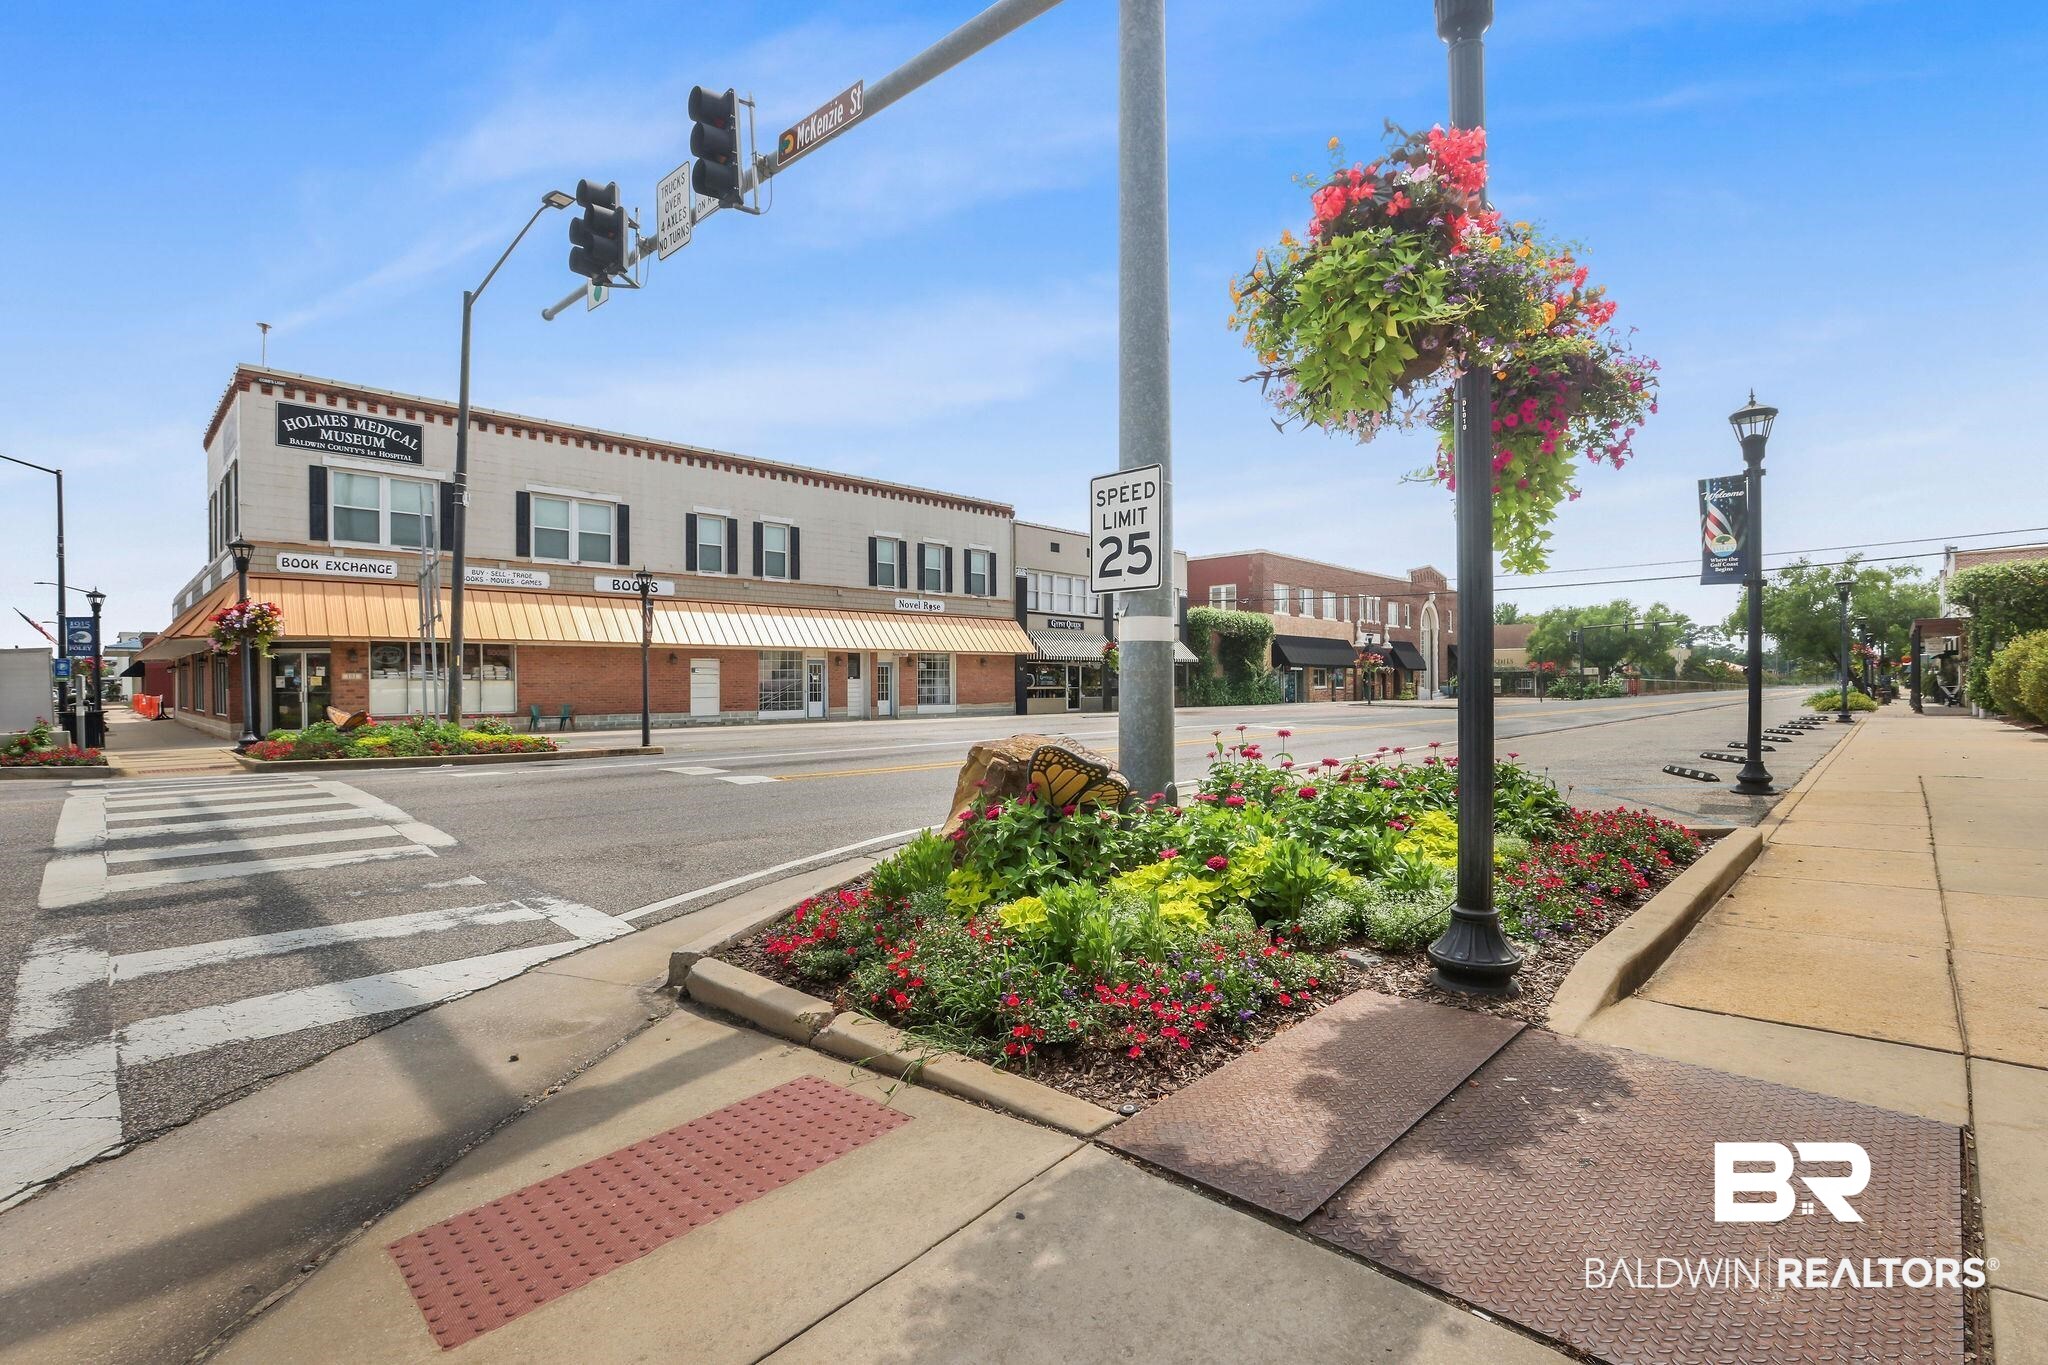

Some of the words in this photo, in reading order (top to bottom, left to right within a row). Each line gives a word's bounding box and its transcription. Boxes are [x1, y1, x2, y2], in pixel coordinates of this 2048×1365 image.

[796, 101, 843, 149] McKenzie
[850, 84, 862, 115] St
[661, 172, 685, 199] TRUCKS
[665, 193, 682, 214] OVER
[698, 201, 705, 213] ON
[661, 221, 665, 233] 4
[667, 206, 687, 230] AXLES
[659, 237, 668, 253] NO
[669, 222, 690, 246] TURNS
[282, 414, 348, 431] HOLMES
[354, 417, 419, 451] MEDICAL
[320, 428, 386, 449] MUSEUM
[289, 437, 326, 449] BALDWIN
[327, 443, 365, 455] COUNTY'S
[367, 449, 376, 457] 1st
[379, 451, 413, 462] HOSPITAL
[1096, 481, 1156, 507] SPEED
[1701, 488, 1745, 501] Welcome
[1103, 507, 1148, 530] LIMIT
[281, 557, 319, 570] BOOK
[325, 560, 393, 575] EXCHANGE
[1099, 531, 1153, 578] 25
[490, 577, 515, 585] MOVIES
[612, 579, 659, 593] BOOS
[899, 599, 921, 610] Novel
